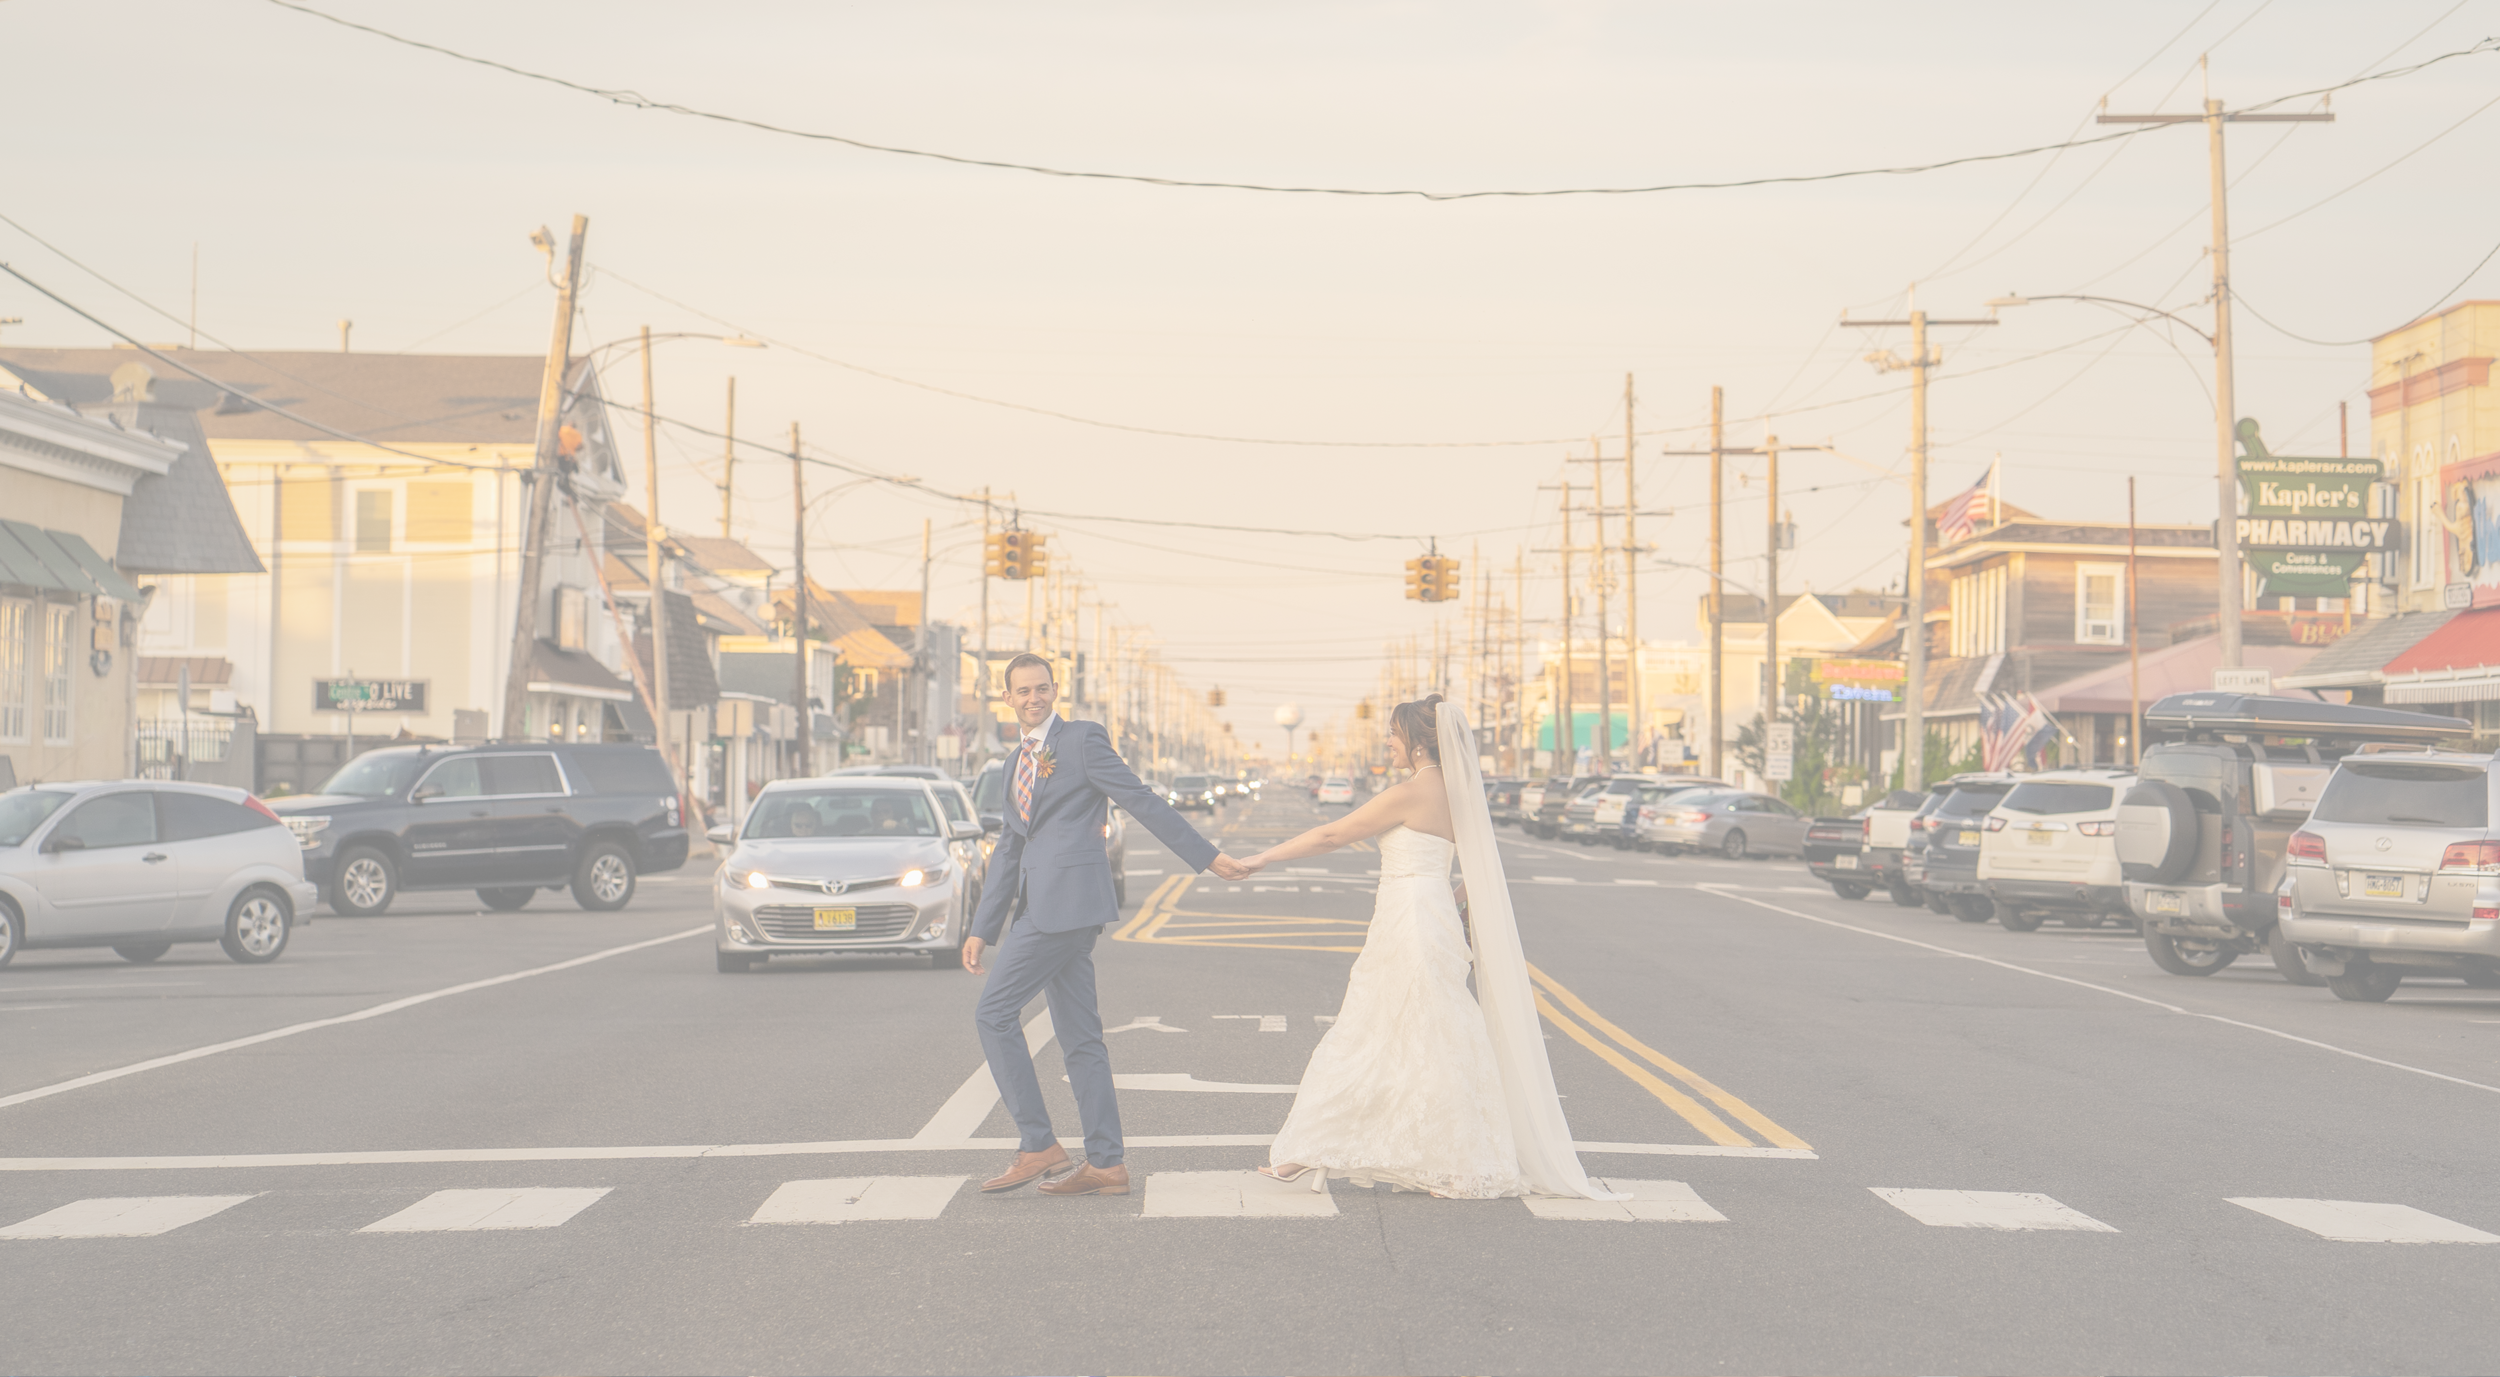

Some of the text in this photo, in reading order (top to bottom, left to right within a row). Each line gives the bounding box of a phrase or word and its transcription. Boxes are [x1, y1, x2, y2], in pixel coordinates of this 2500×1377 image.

[2240, 459, 2378, 474] www.kaplersrx.com
[2258, 481, 2360, 515] Kapler's
[2236, 519, 2389, 547] PHARMACY
[2286, 552, 2328, 565] Cures &
[2272, 561, 2342, 575] Conveniences
[2218, 675, 2267, 686] LEFT LANE
[383, 681, 412, 700] LIVE
[1830, 684, 1893, 701] Tavern
